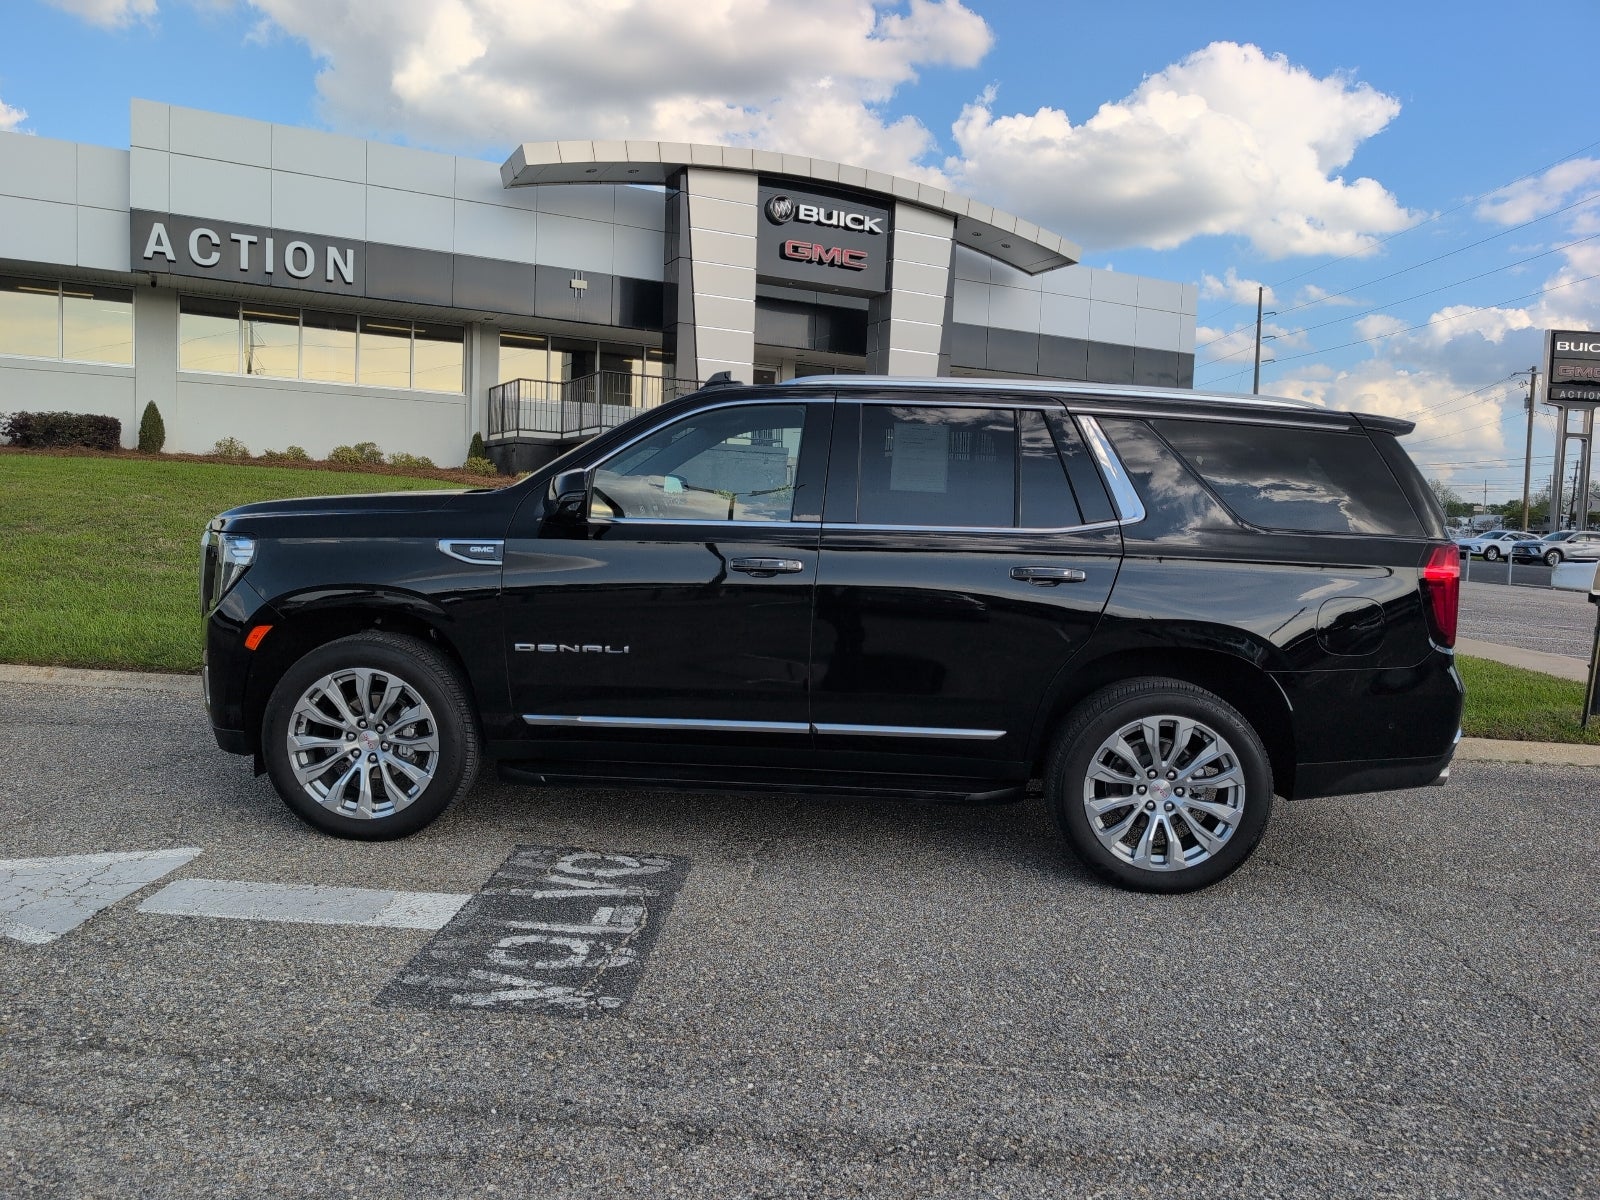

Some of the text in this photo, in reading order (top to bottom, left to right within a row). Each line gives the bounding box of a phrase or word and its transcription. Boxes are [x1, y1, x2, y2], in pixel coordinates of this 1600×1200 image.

[798, 203, 884, 234] BUICK
[143, 222, 355, 285] ACTION
[784, 239, 868, 270] GMC
[470, 545, 495, 554] GMC
[514, 642, 630, 655] DENALI
